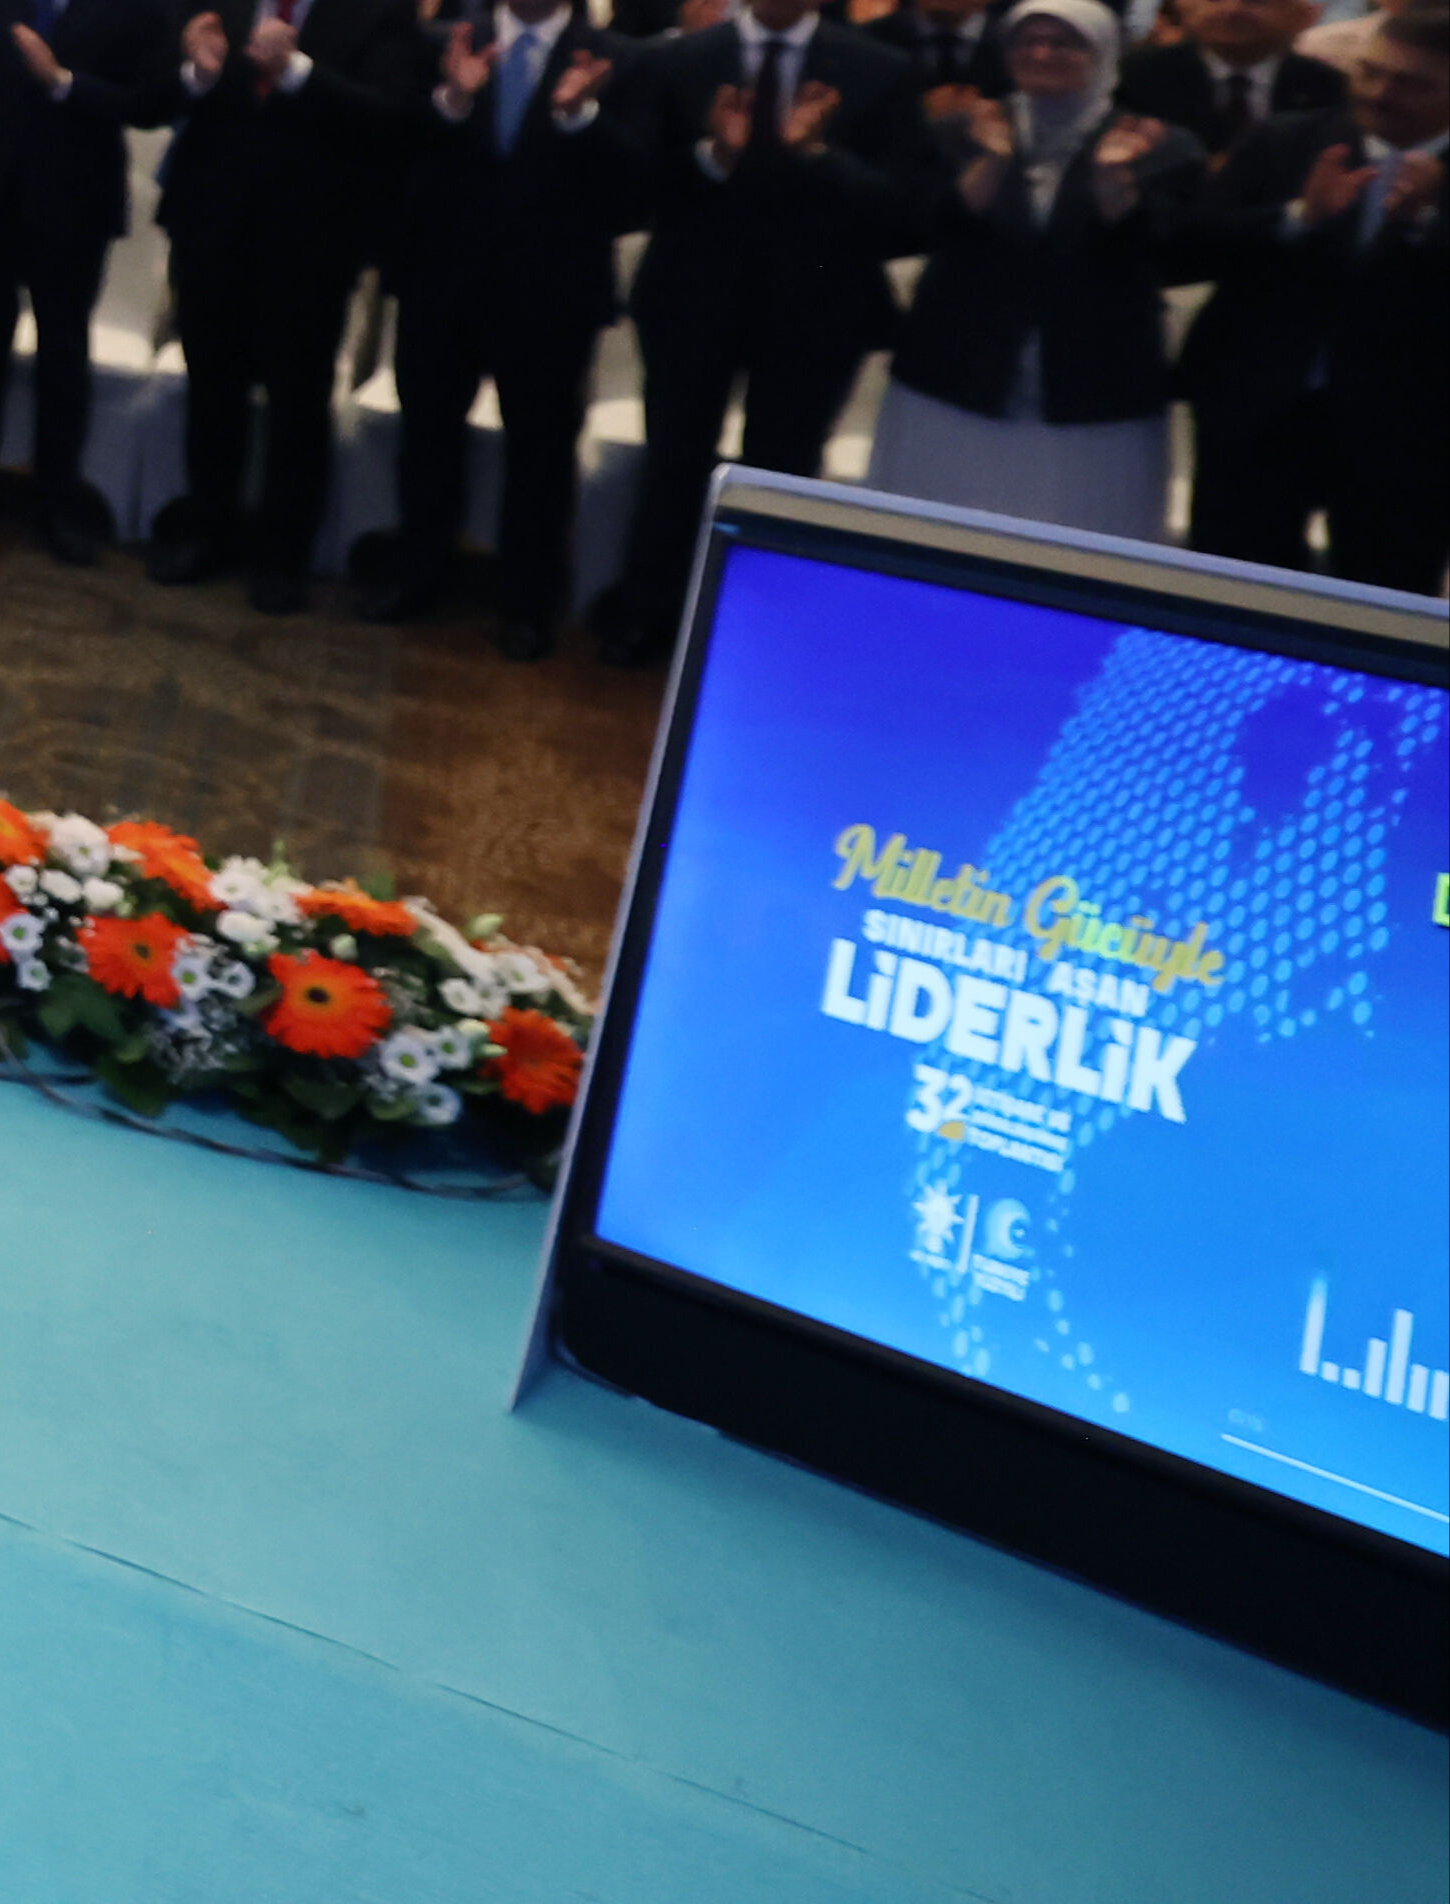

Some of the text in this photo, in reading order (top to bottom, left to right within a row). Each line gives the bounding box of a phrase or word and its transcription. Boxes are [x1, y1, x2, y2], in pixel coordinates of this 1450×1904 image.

[831, 823, 1227, 993] Milletin Gücüyle
[861, 908, 1150, 1018] SINIRLARI AŞAN
[821, 937, 1198, 1125] LİDERLİK
[906, 1063, 973, 1141] 32
